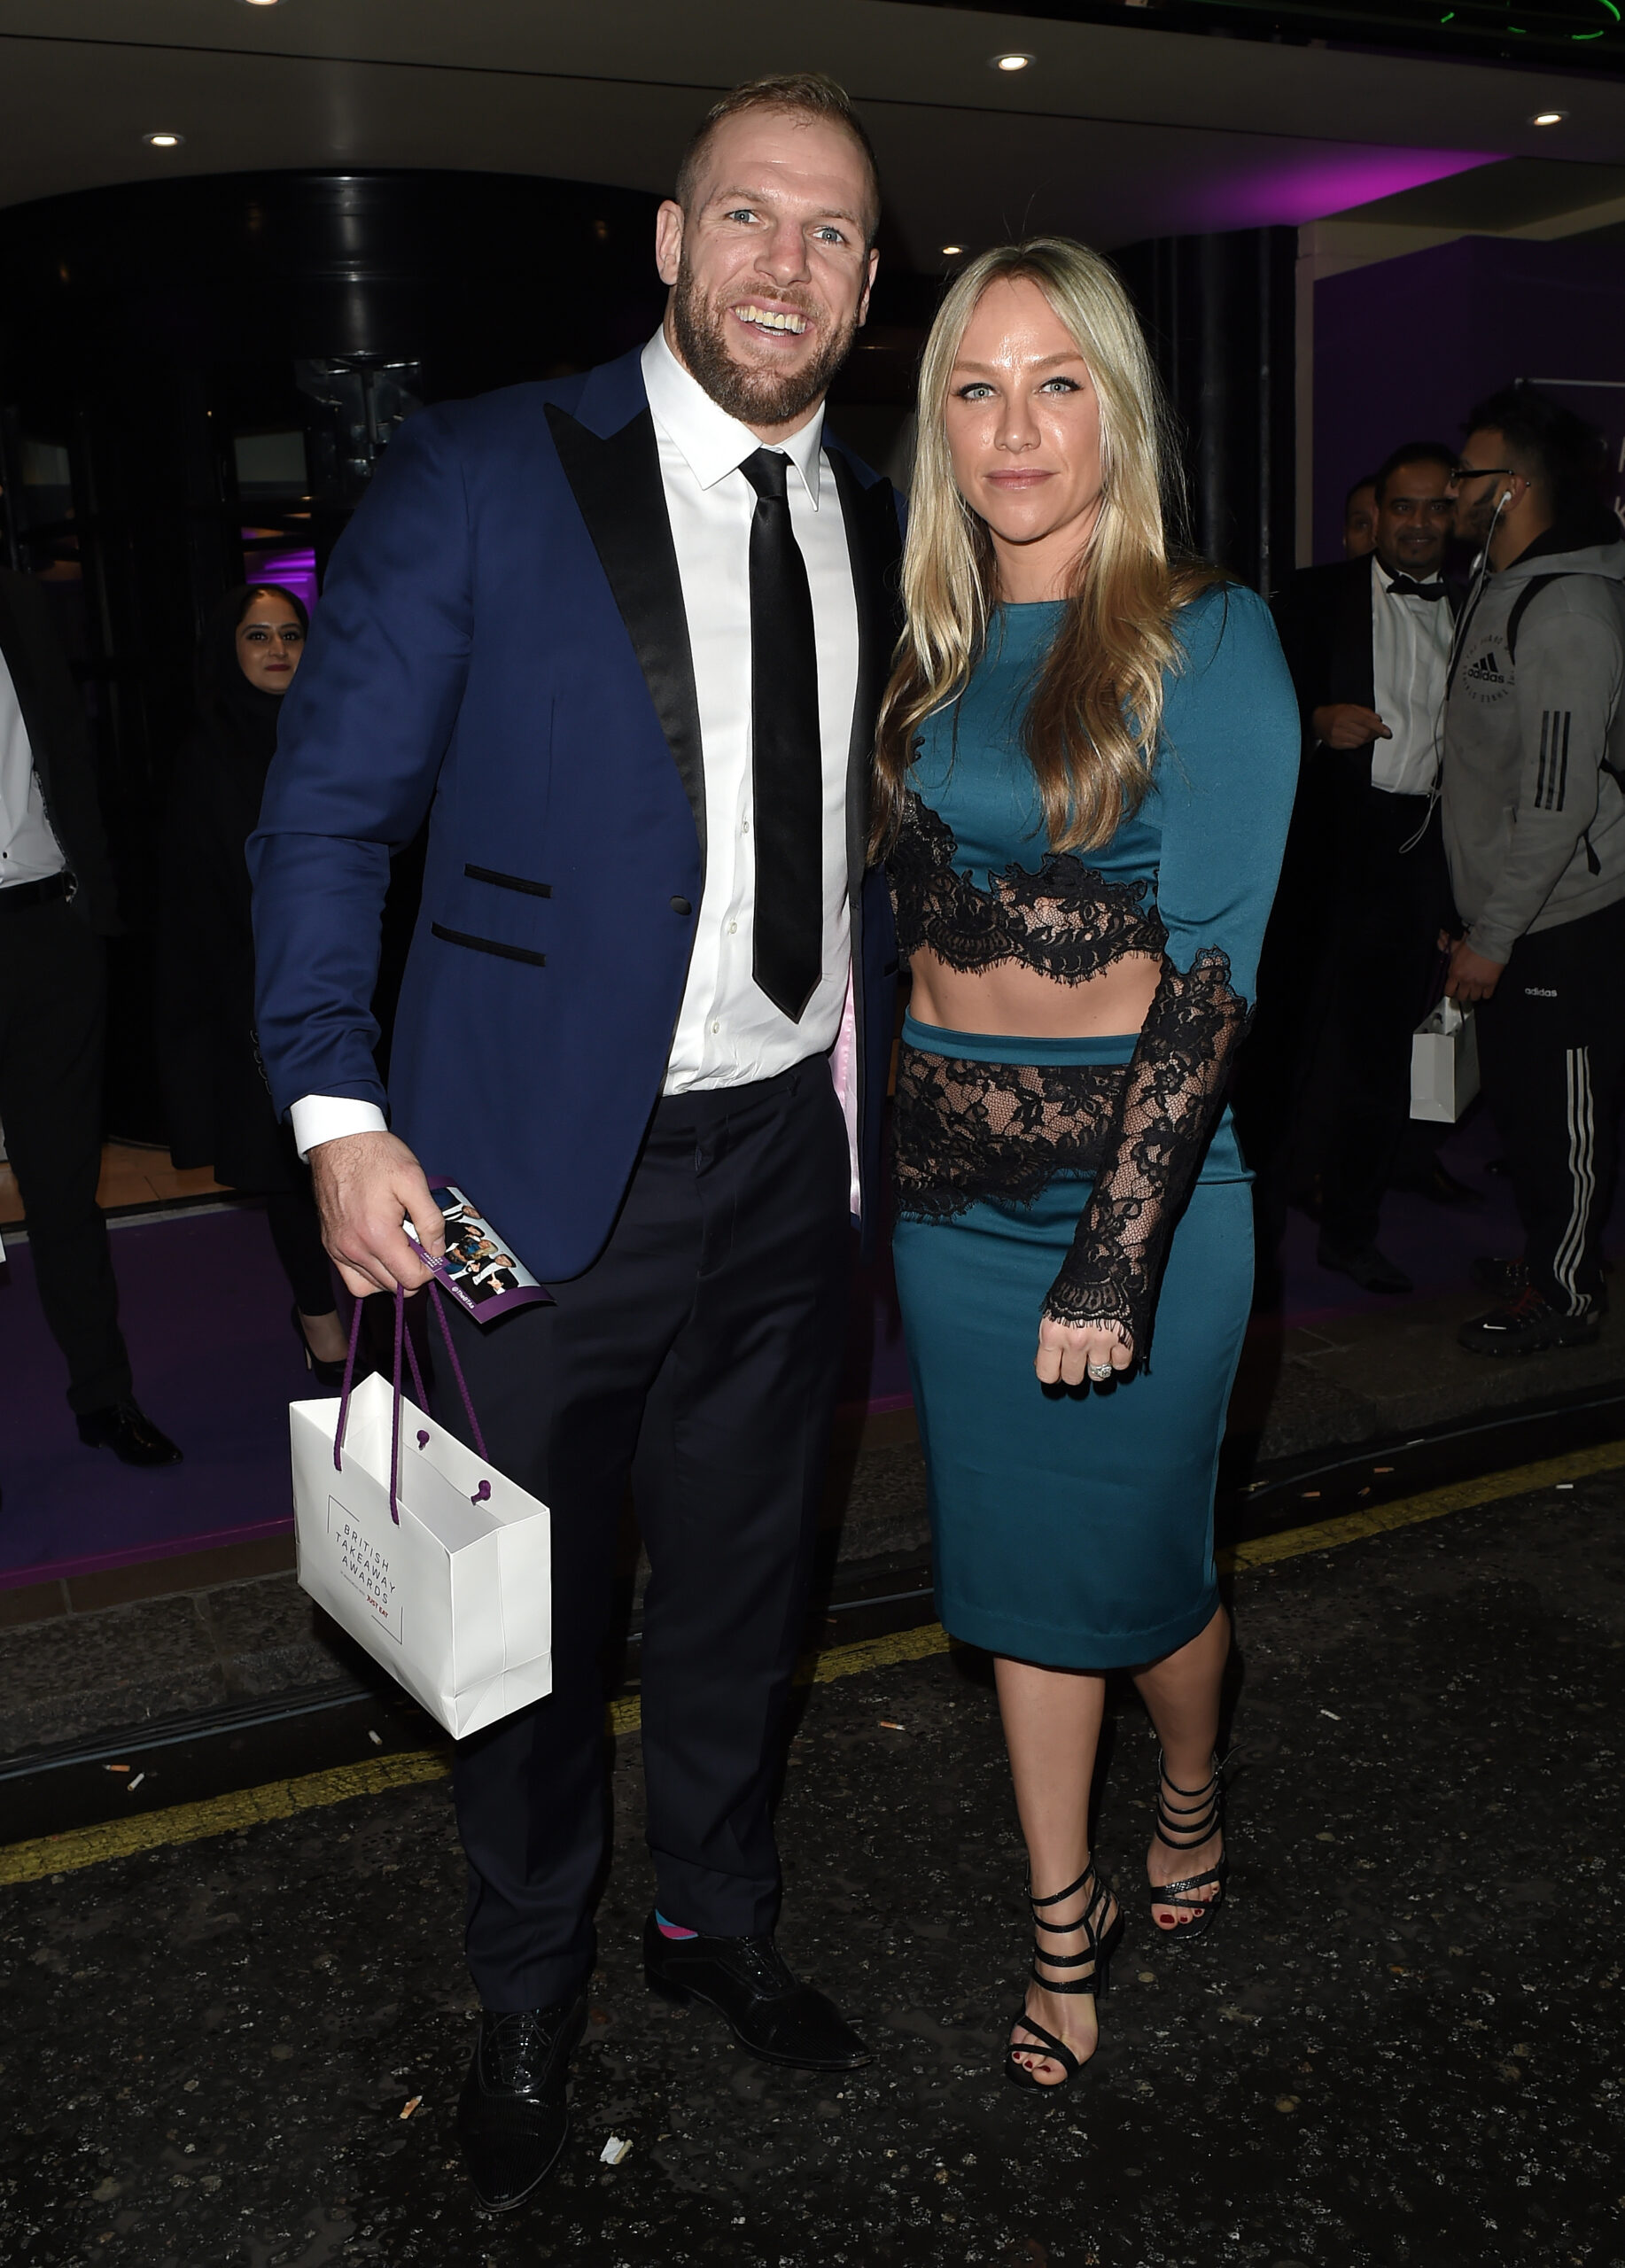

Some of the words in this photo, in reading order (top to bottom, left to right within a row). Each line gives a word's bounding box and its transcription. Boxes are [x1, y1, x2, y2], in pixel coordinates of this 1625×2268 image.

[1467, 668, 1504, 684] adidas
[1525, 987, 1558, 998] adidas
[335, 1532, 396, 1593] TAKEAWAY
[344, 1524, 389, 1573] BRITISH
[341, 1556, 388, 1604] AWARDS
[366, 1595, 378, 1609] JUST
[378, 1607, 389, 1619] EAT
